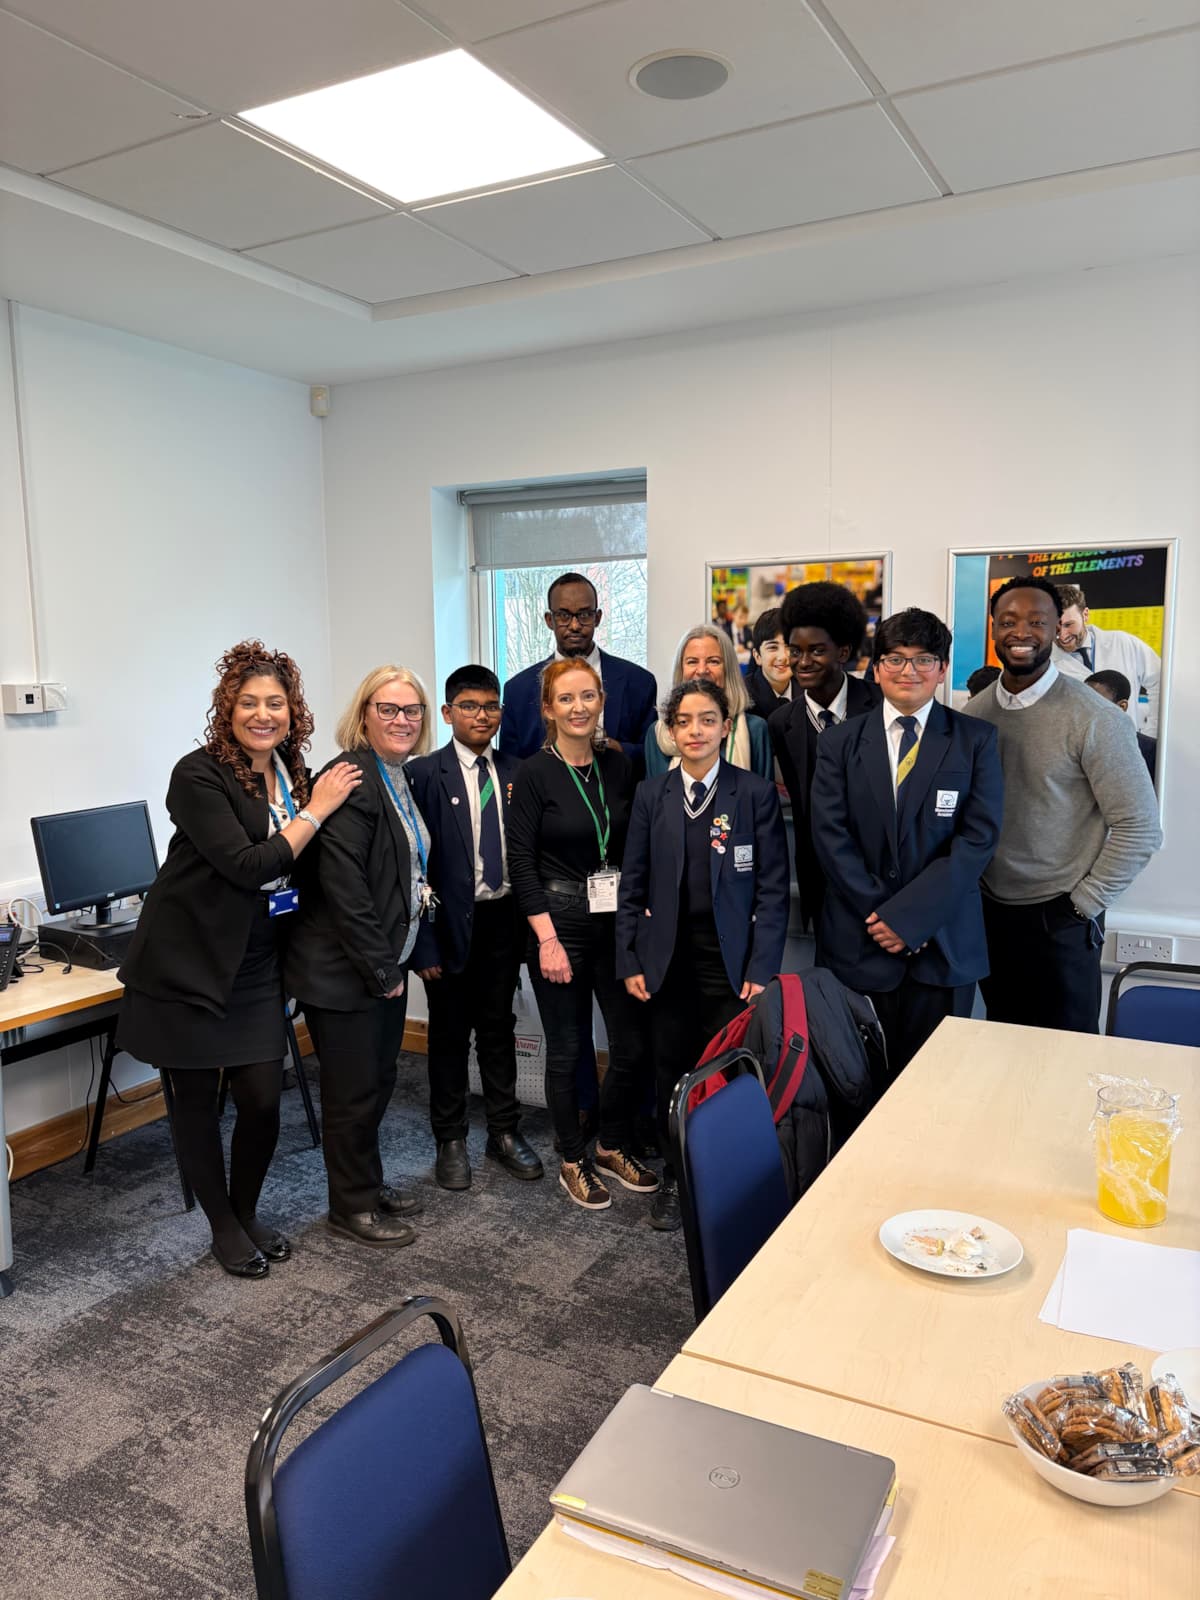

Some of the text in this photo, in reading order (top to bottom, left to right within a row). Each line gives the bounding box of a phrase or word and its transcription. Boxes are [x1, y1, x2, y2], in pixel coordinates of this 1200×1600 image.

[1028, 553, 1049, 564] THE
[1032, 554, 1144, 577] OF THE ELEMENTS
